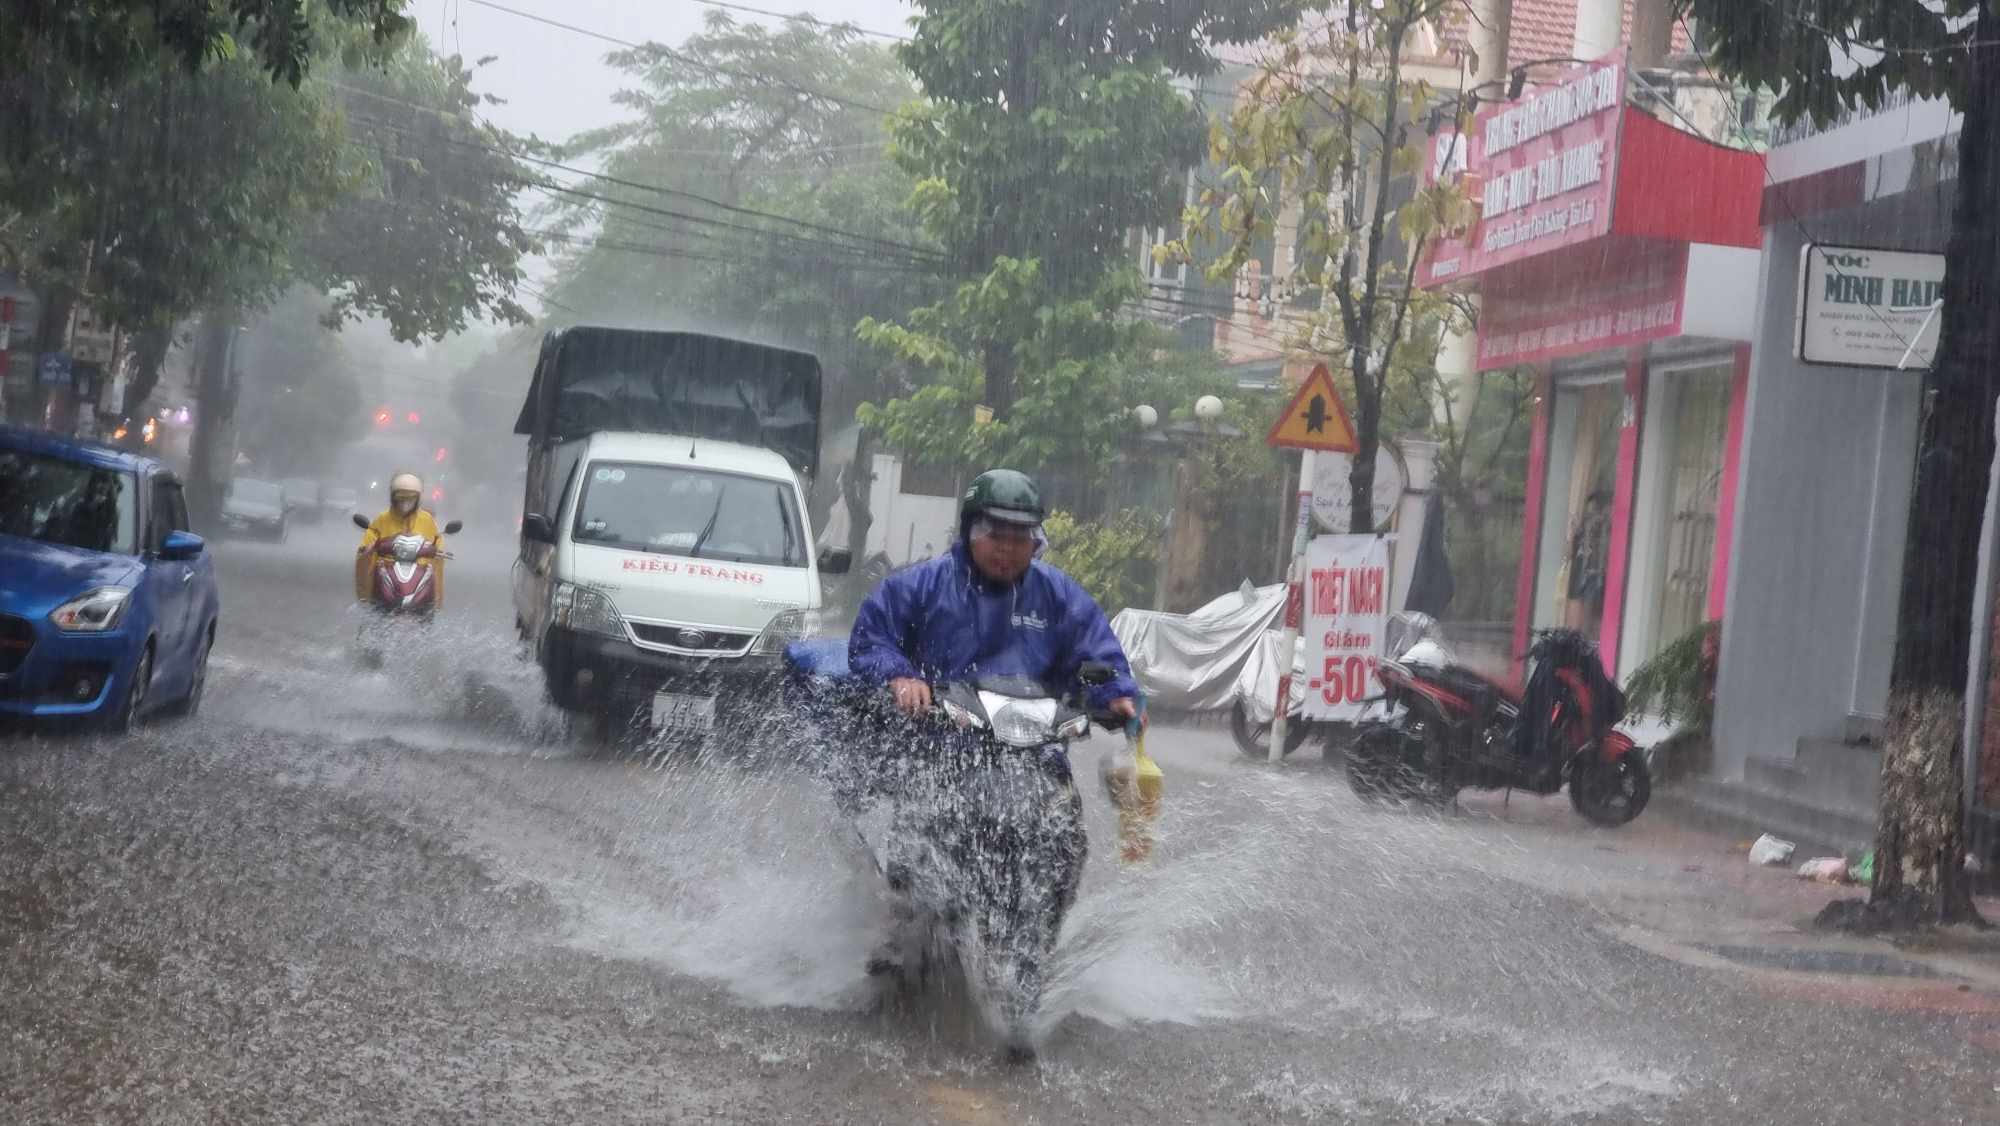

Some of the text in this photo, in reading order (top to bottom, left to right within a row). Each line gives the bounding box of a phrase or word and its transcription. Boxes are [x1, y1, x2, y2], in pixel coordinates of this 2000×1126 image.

[1823, 273, 1884, 306] MINH
[1316, 496, 1333, 509] Spa
[683, 562, 764, 584] TRANG
[1348, 556, 1384, 616] NÁCH
